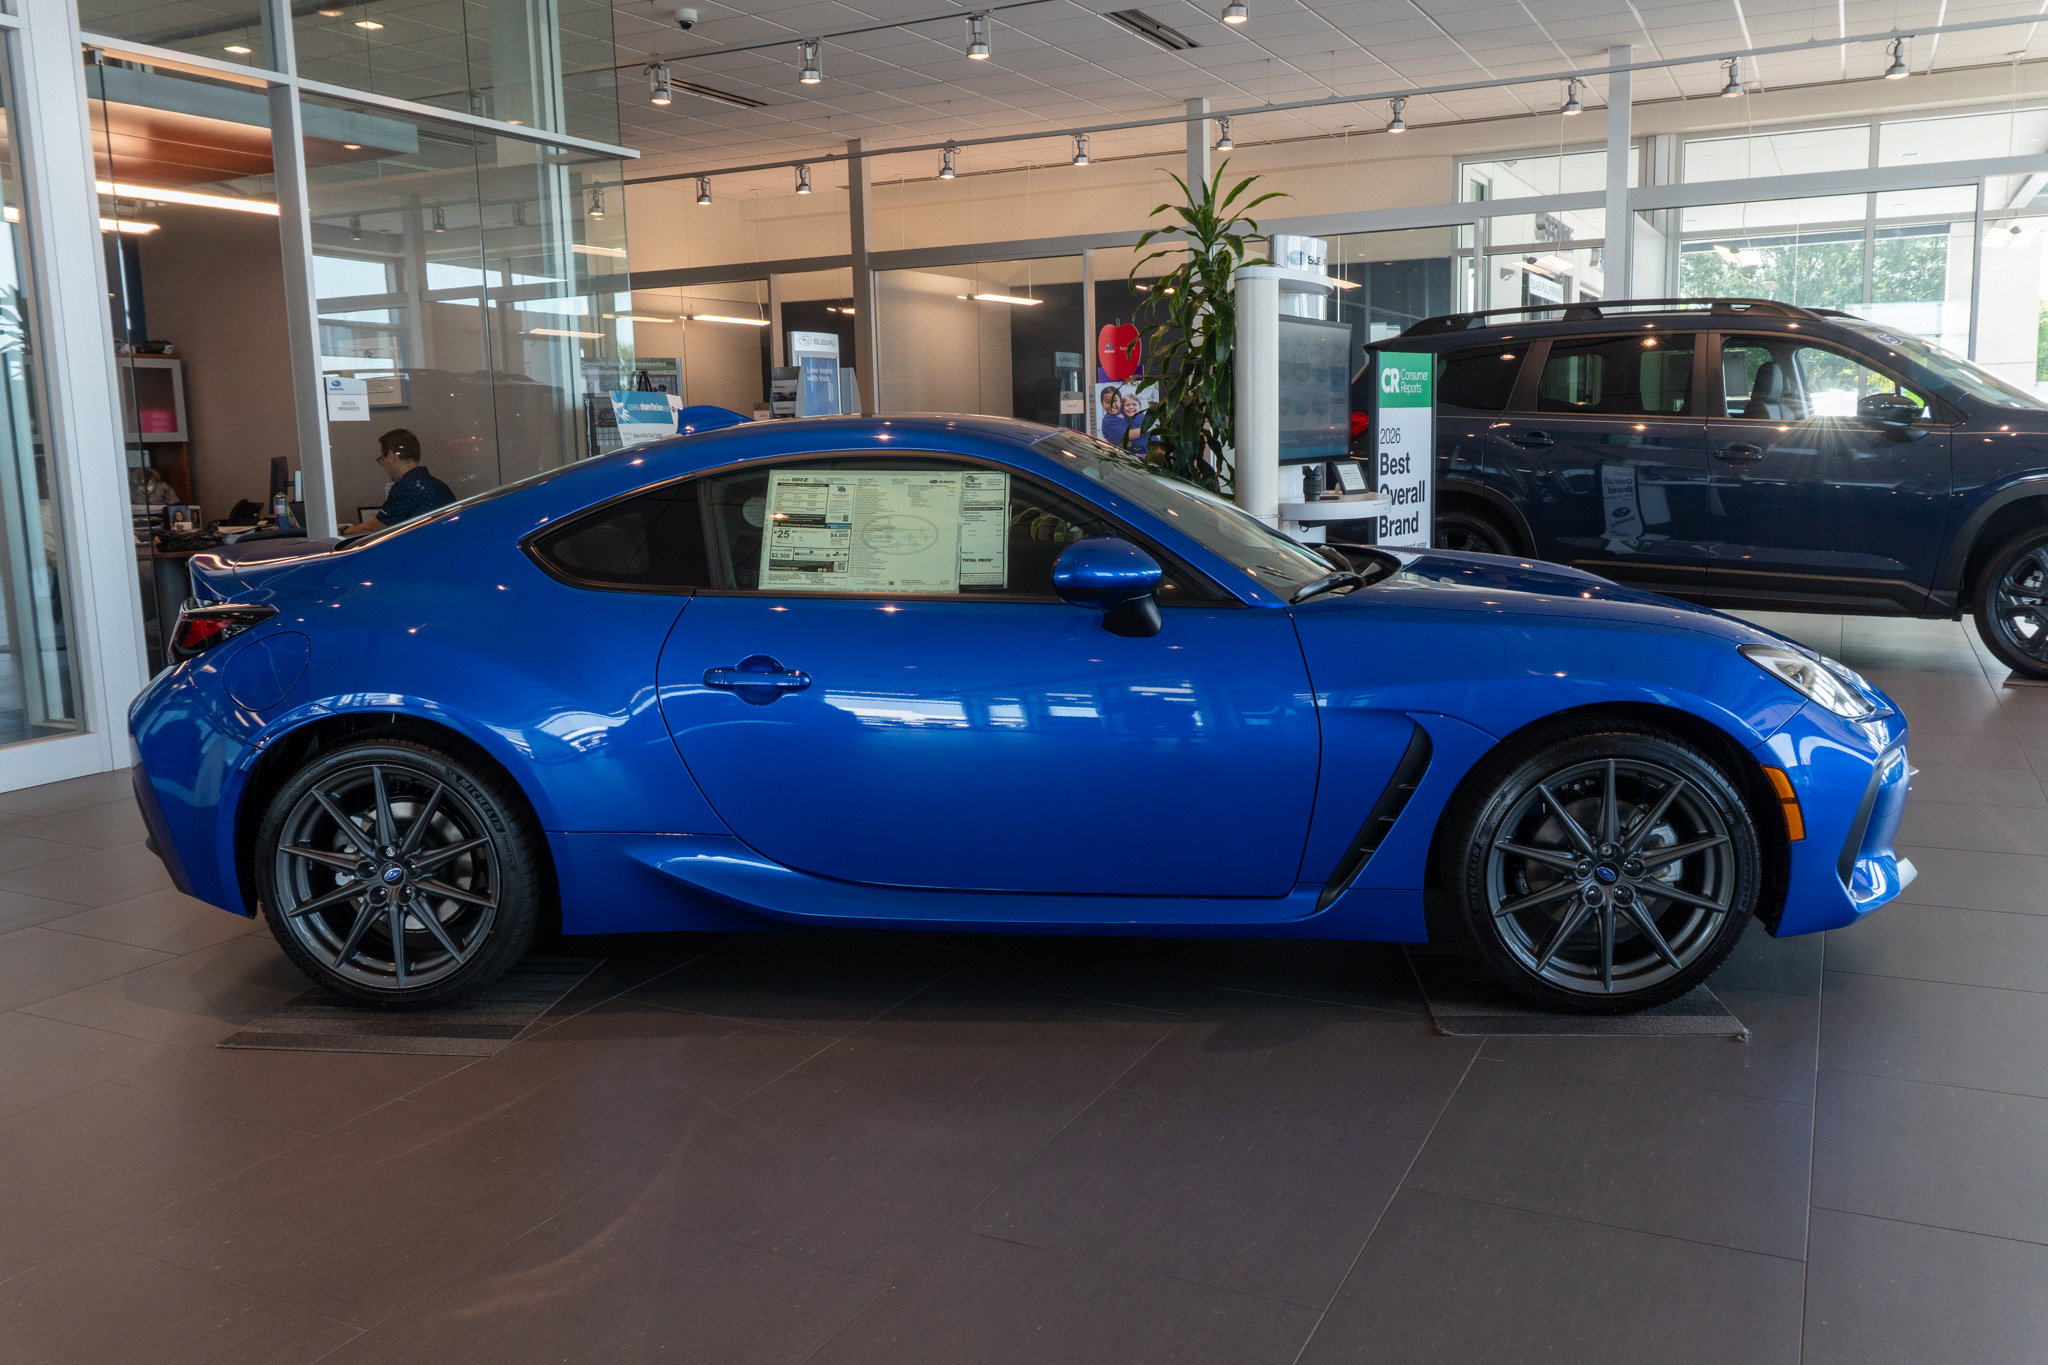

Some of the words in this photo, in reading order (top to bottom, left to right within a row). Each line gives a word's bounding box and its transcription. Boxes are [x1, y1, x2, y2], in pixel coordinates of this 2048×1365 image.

[813, 338, 836, 347] SUBARU
[1381, 367, 1400, 394] CR
[1400, 368, 1429, 381] Consumer
[1400, 381, 1422, 396] Reports
[1380, 427, 1401, 444] 2026
[1380, 452, 1411, 475] Best
[777, 530, 790, 539] 25
[1379, 510, 1419, 539] Brand
[458, 777, 505, 832] MICHELIN
